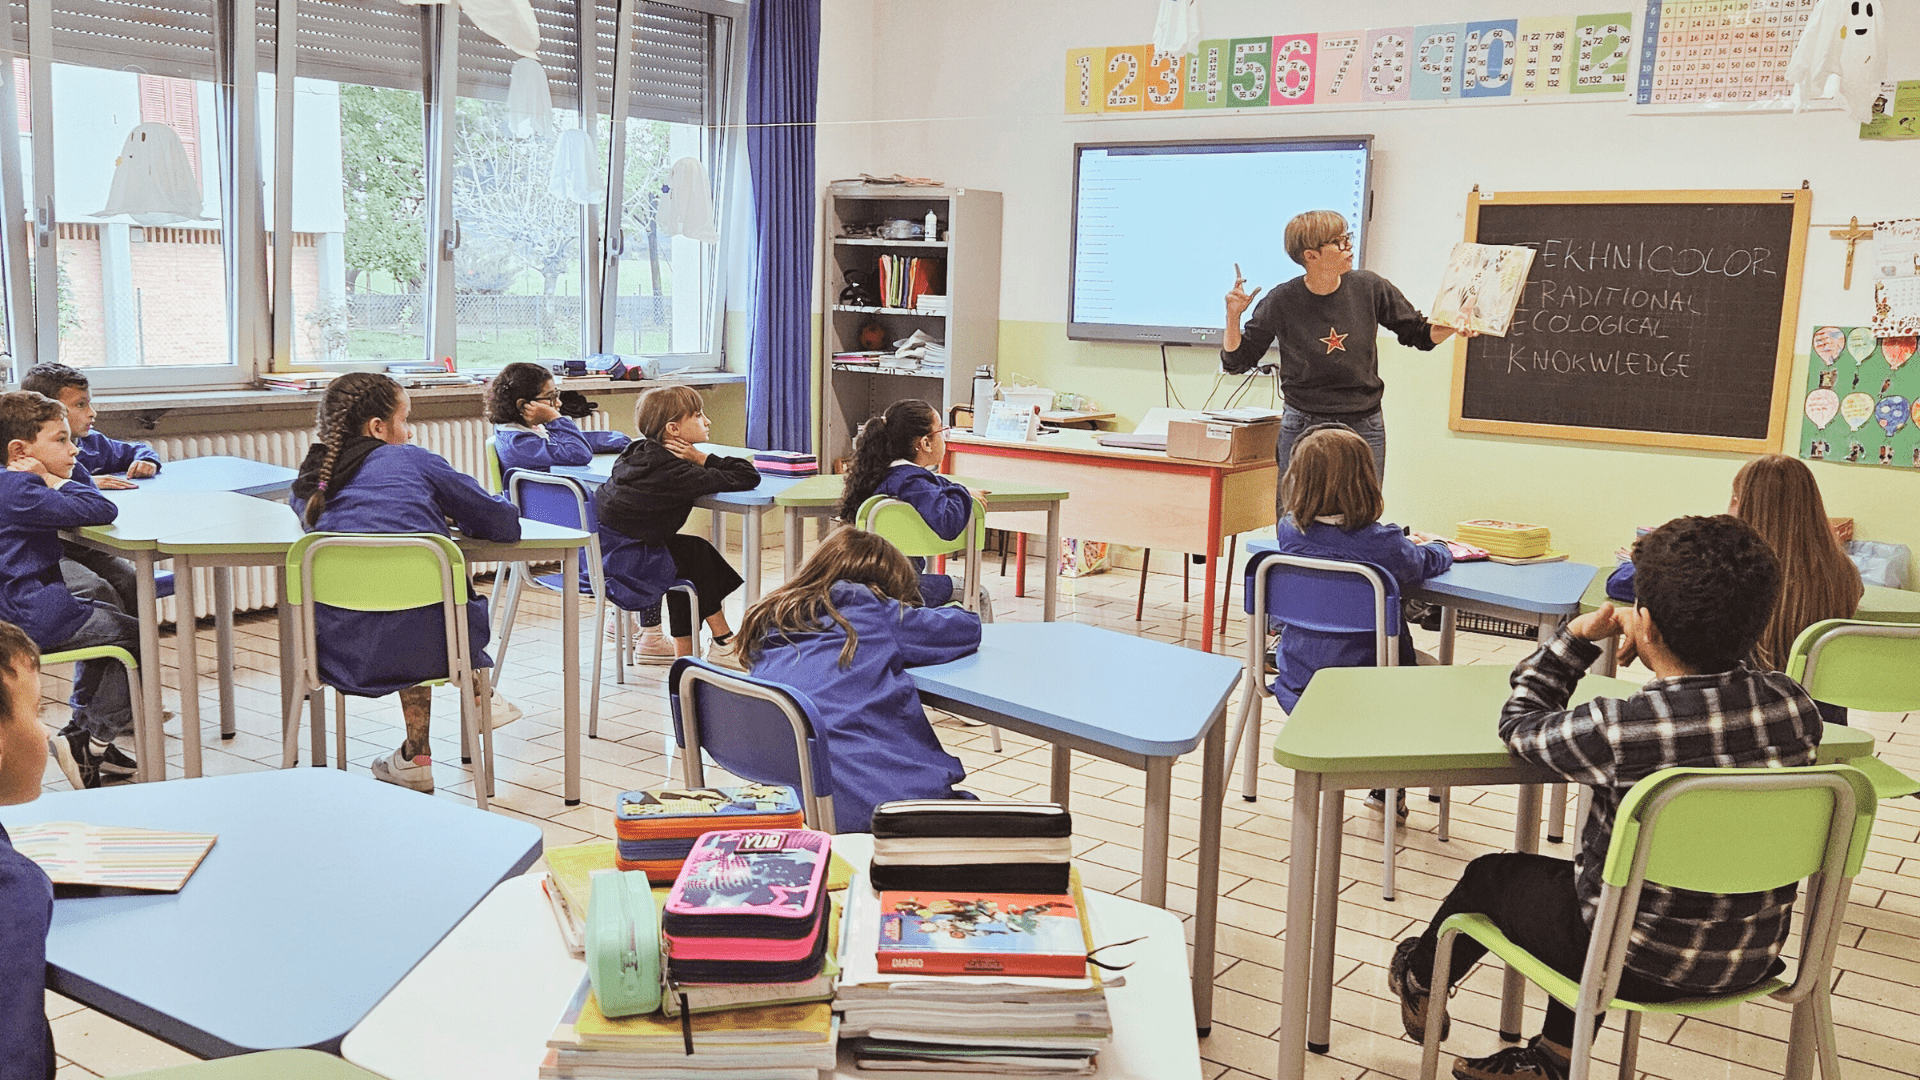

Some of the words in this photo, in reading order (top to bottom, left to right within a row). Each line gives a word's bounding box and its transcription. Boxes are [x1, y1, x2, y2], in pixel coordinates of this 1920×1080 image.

[1107, 52, 1138, 106] 2
[1189, 48, 1222, 103] 4
[1232, 42, 1267, 101] 5
[1276, 40, 1311, 99] 6
[1323, 38, 1359, 95] 7
[1368, 34, 1405, 94] 8
[1418, 33, 1457, 94] 9
[1463, 29, 1515, 89] 10
[1576, 24, 1631, 86] 12
[1520, 280, 1700, 314] TRADITIONAL
[1510, 308, 1668, 338] ECOLOGICAL
[745, 835, 781, 848] YUB
[891, 957, 924, 968] DIARIO
